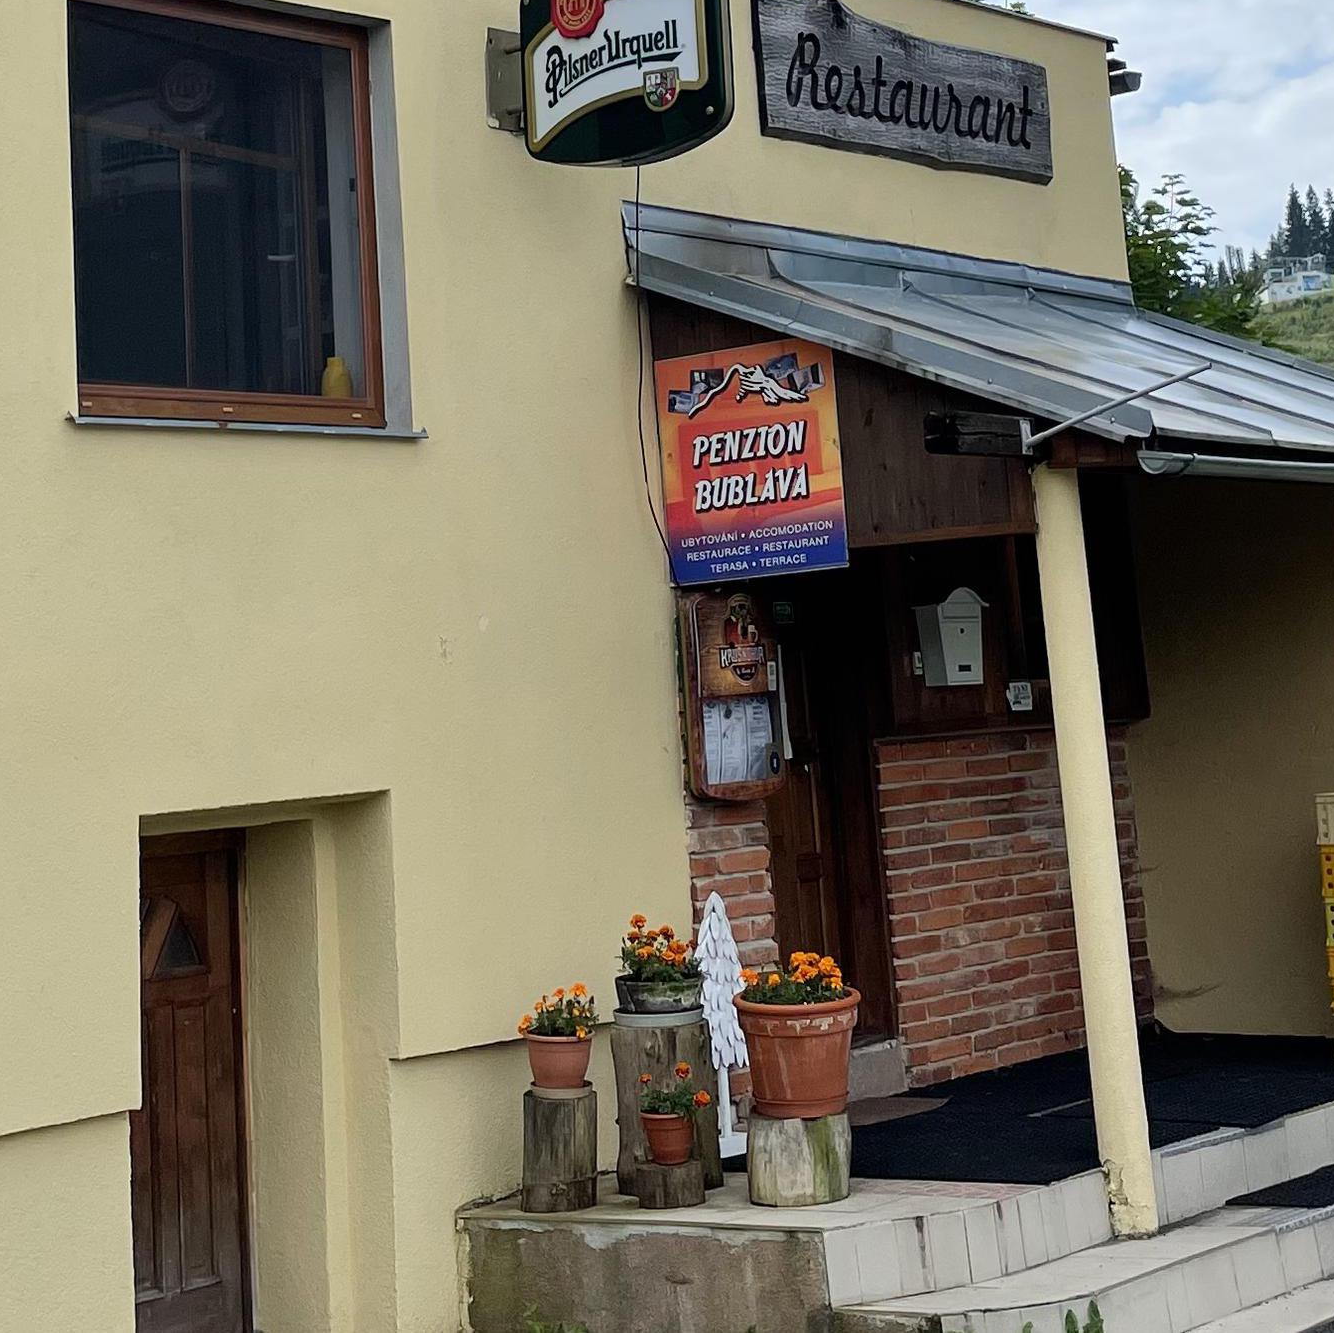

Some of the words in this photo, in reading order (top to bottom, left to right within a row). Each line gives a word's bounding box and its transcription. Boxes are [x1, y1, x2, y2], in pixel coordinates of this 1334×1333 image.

[545, 44, 607, 108] Pilsner
[603, 19, 679, 70] Urquell
[785, 31, 1034, 150] Restaurant
[692, 420, 806, 467] PENZION
[695, 463, 809, 511] BUBLAVA
[681, 530, 738, 548] UBYTOVÁNÍ
[749, 520, 833, 540] ACCOMODATION
[686, 545, 752, 562] RESTAURACE
[762, 535, 830, 553] RESTAURANT
[710, 560, 749, 574] TERASA
[759, 553, 808, 568] TERRACE
